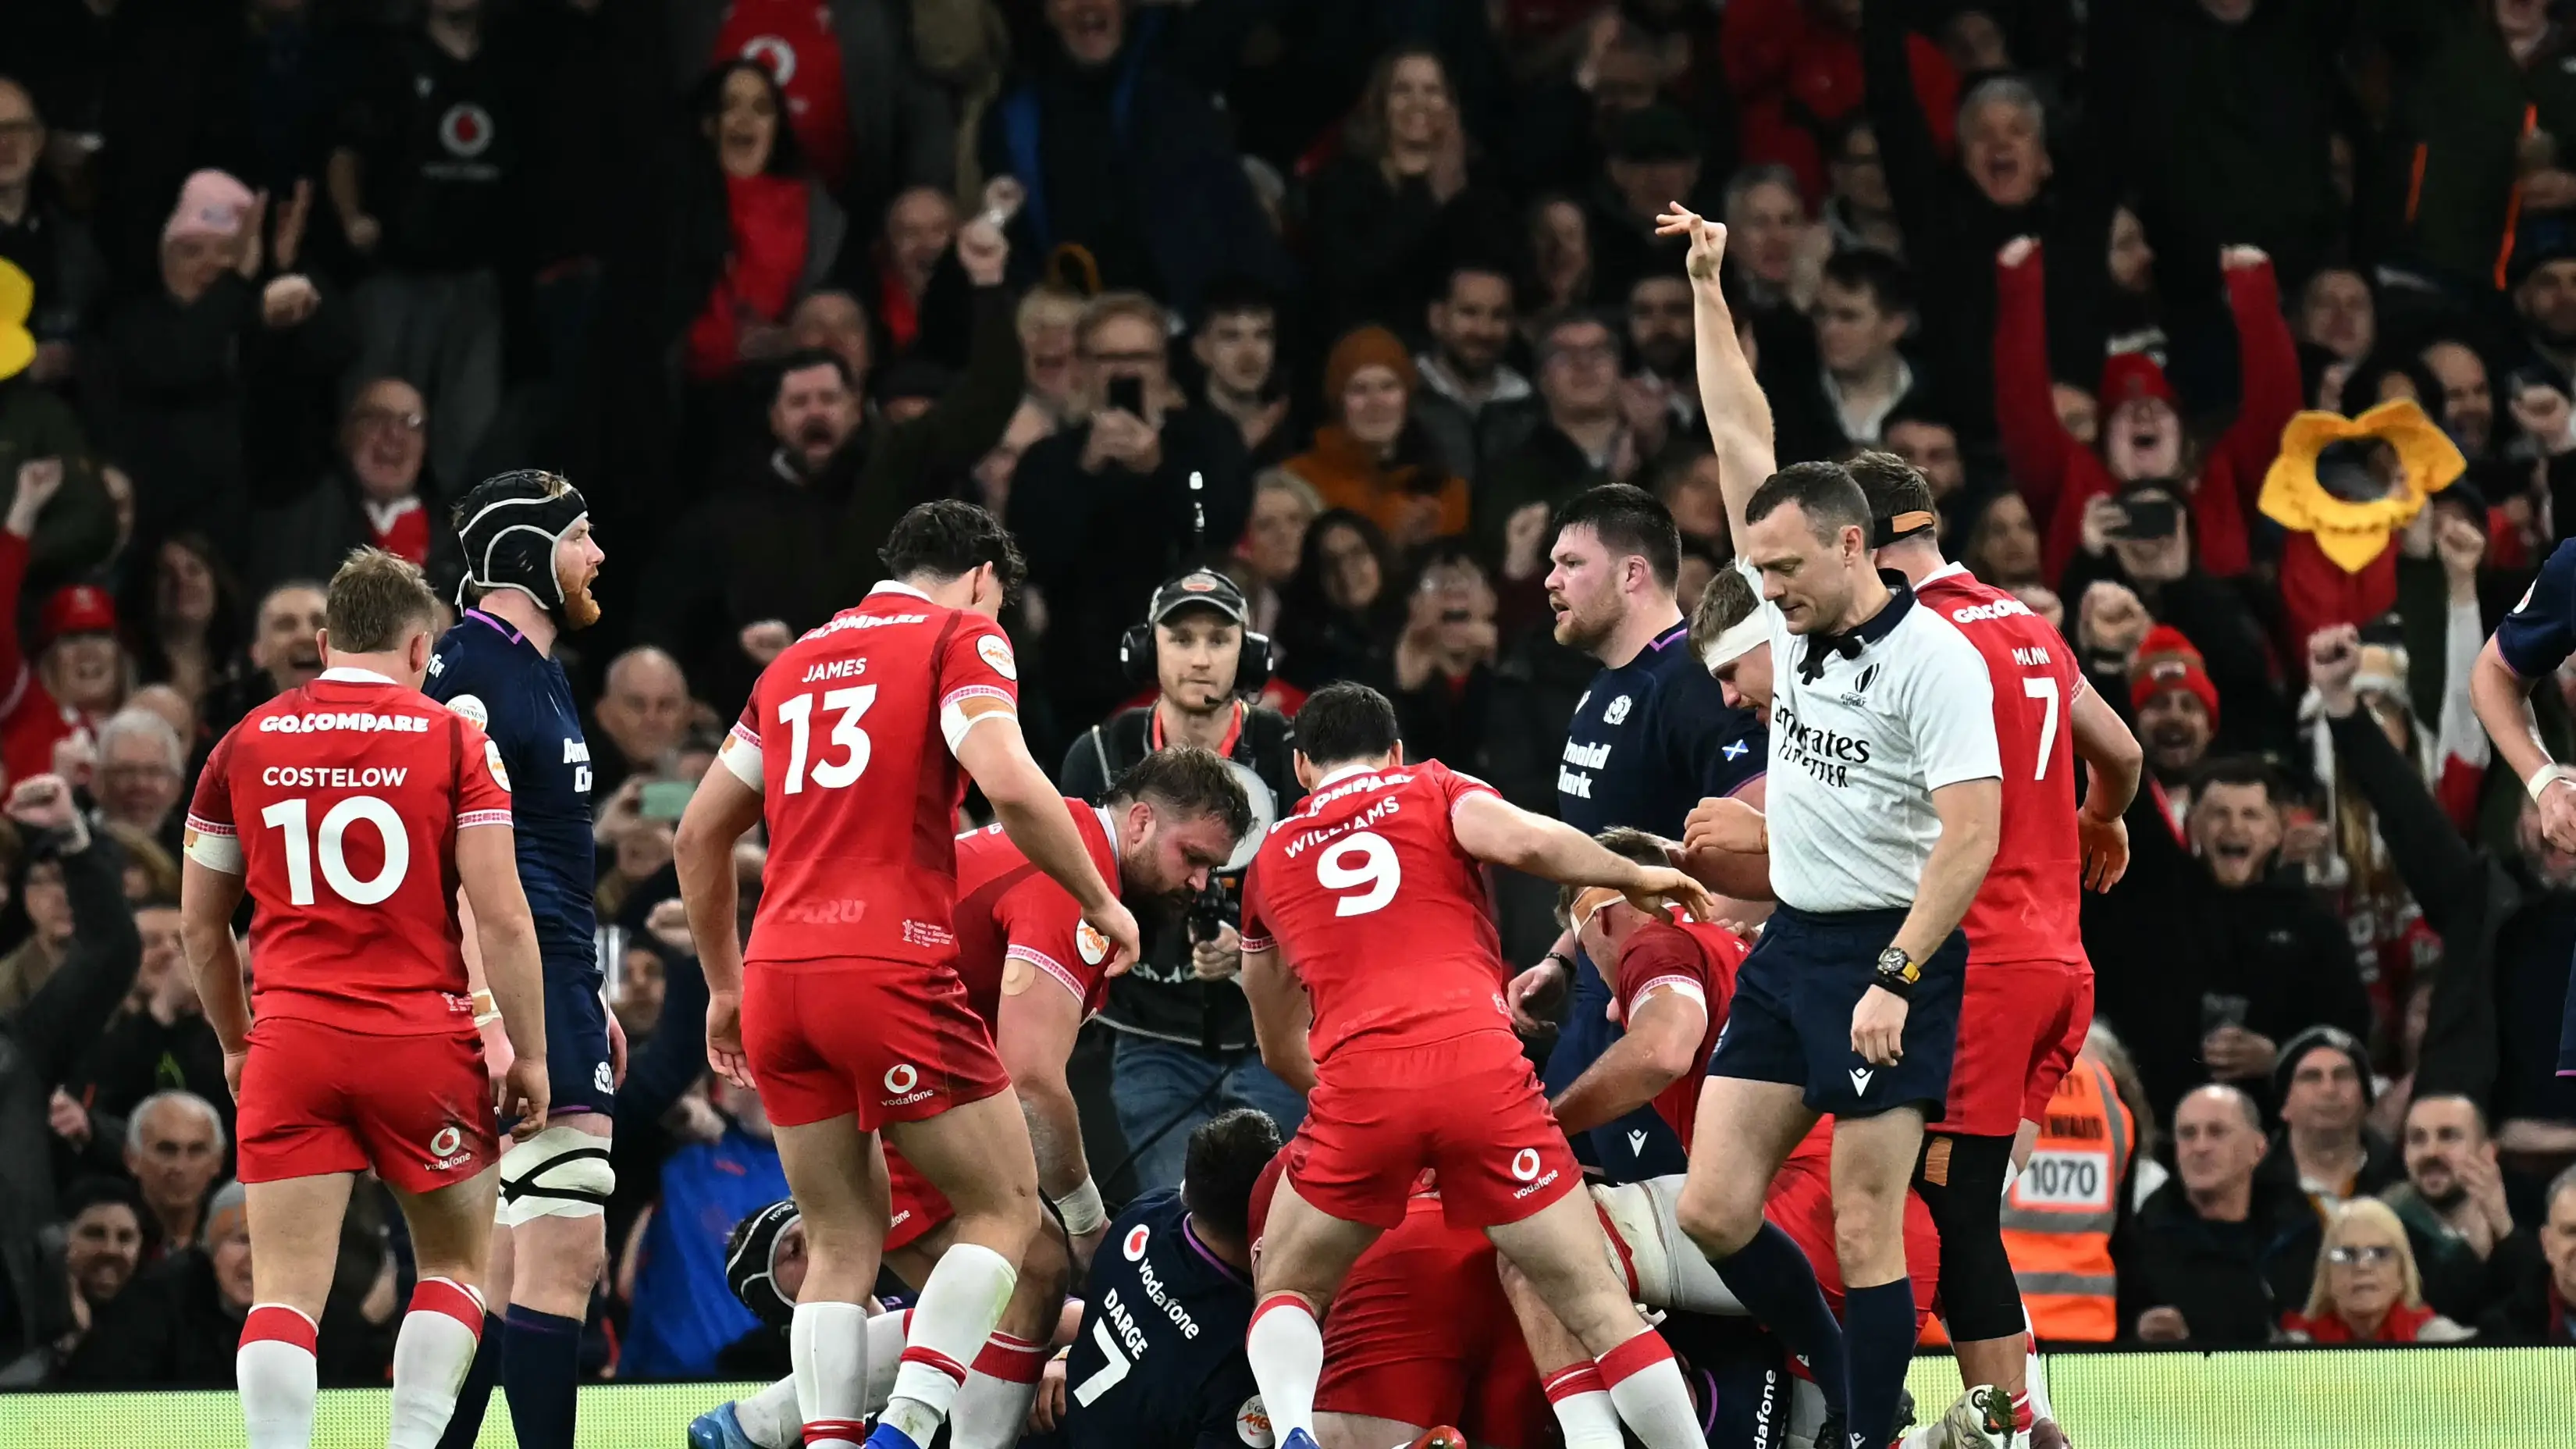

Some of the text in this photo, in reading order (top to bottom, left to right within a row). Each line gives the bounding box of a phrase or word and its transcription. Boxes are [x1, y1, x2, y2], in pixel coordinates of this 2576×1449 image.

[802, 657, 866, 683] JAMES
[259, 713, 429, 733] GO.COMPARE
[778, 684, 877, 795] 13
[1773, 692, 1870, 764] mrates
[2023, 677, 2059, 781] 7
[262, 767, 407, 787] COSTELOW
[1562, 735, 1611, 770] rnold
[1557, 764, 1592, 799] lark
[261, 796, 409, 905] 10
[1317, 831, 1401, 917] 9
[881, 1089, 934, 1106] vodafone
[425, 1153, 471, 1170] vodafone
[1513, 1170, 1558, 1199] vodafone
[2030, 1159, 2097, 1197] 1070
[1104, 1287, 1148, 1360] DARGE
[1139, 1258, 1200, 1340] vodafone
[1073, 1316, 1131, 1408] 7
[1754, 1370, 1776, 1449] dafone
